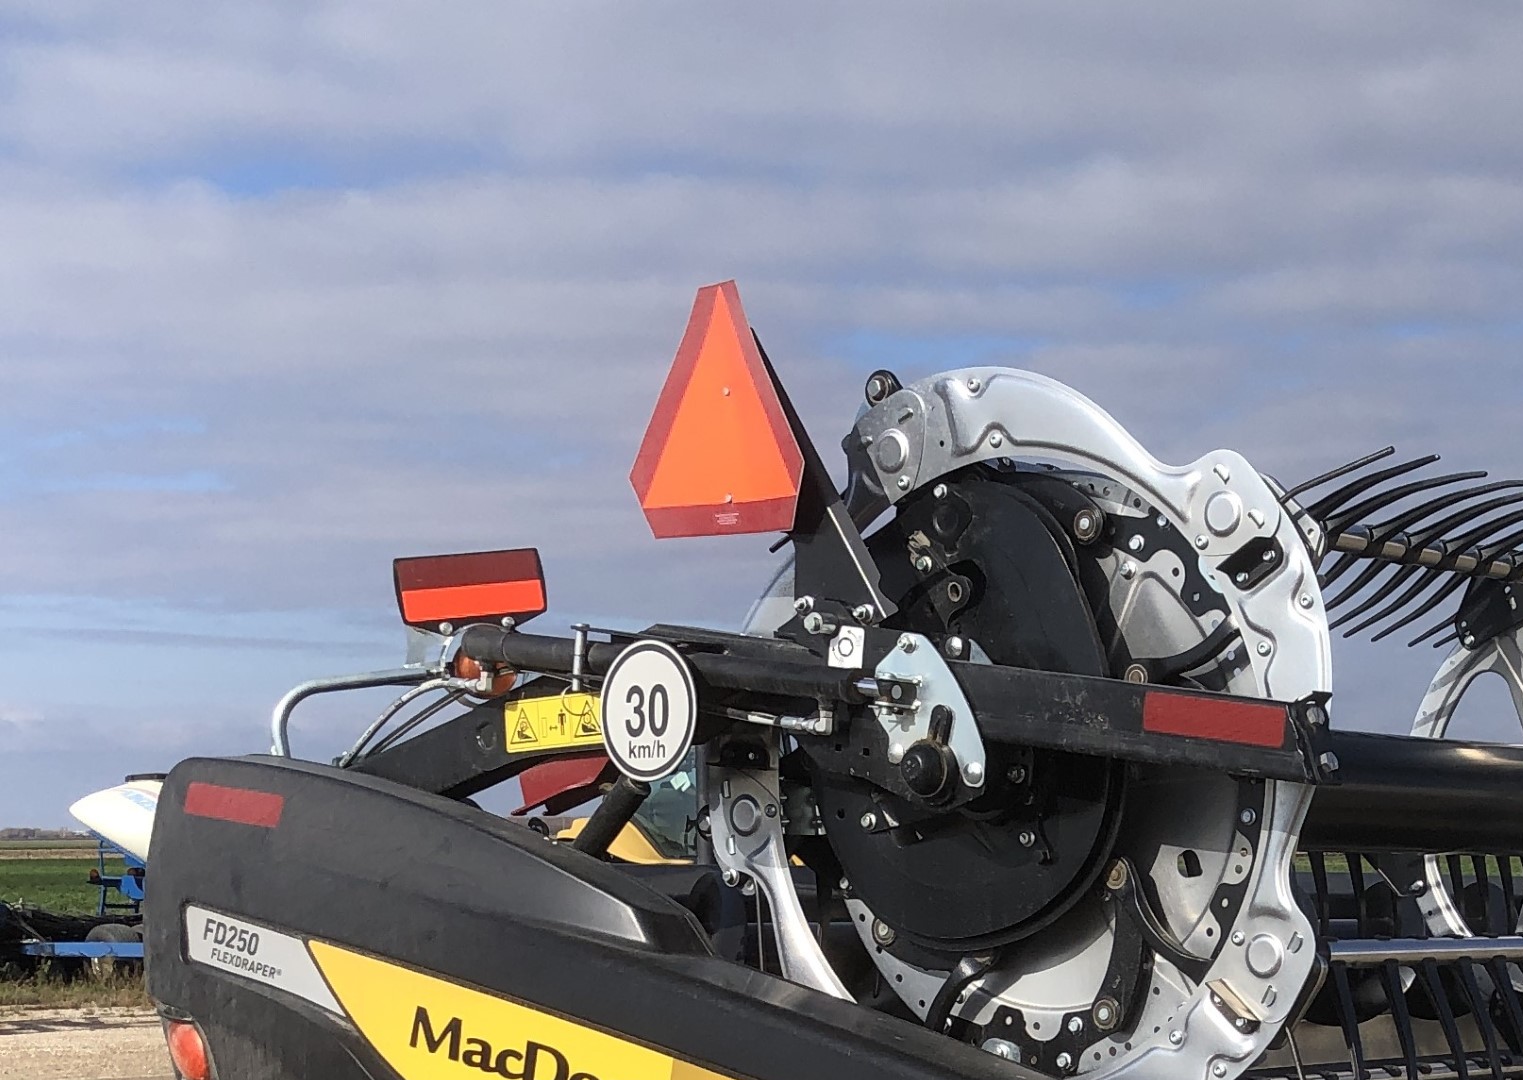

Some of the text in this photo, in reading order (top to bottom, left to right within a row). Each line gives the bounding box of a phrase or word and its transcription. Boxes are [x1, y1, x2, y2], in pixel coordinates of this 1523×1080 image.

[625, 683, 669, 738] 30
[628, 740, 666, 759] km/h
[203, 917, 260, 956] FD250
